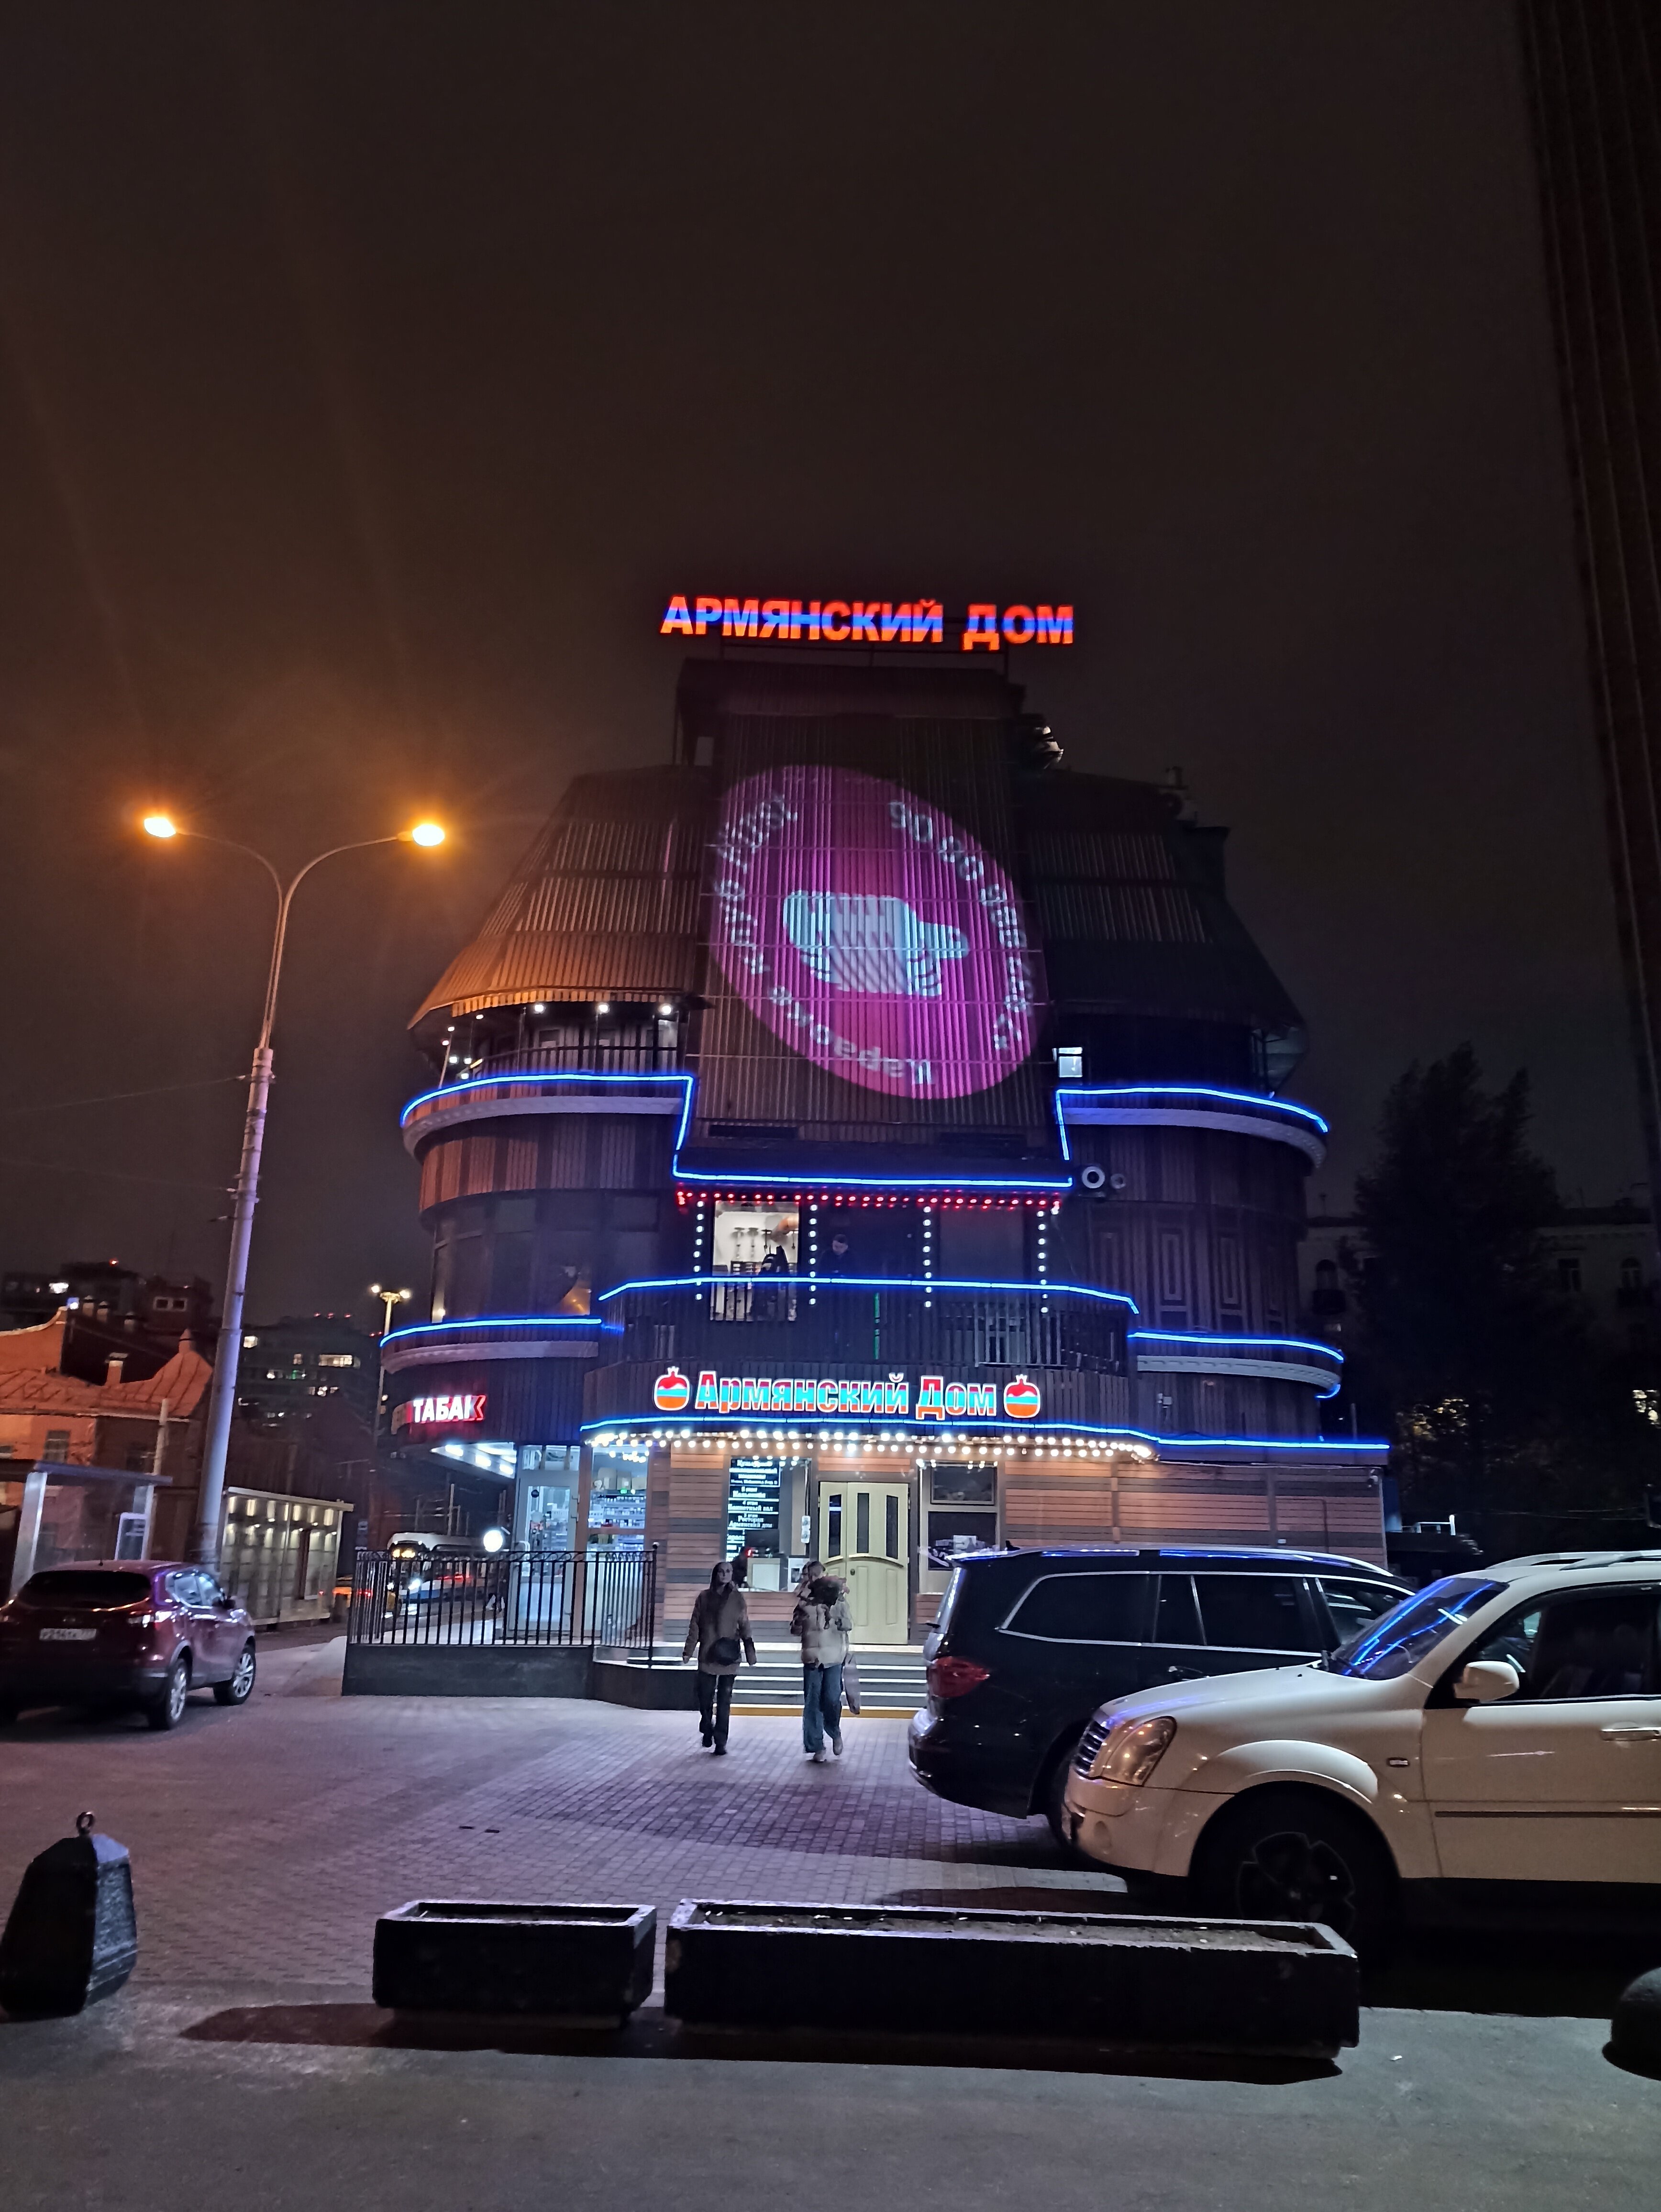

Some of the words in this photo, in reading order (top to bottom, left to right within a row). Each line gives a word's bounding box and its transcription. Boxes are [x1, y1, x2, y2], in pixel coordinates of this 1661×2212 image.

[660, 596, 943, 642] АРМЯНСКИЙ
[962, 604, 1074, 650] ДОМ
[413, 1394, 486, 1423] ТАБАК
[695, 1370, 908, 1415] Армянский
[916, 1374, 997, 1421] Дом
